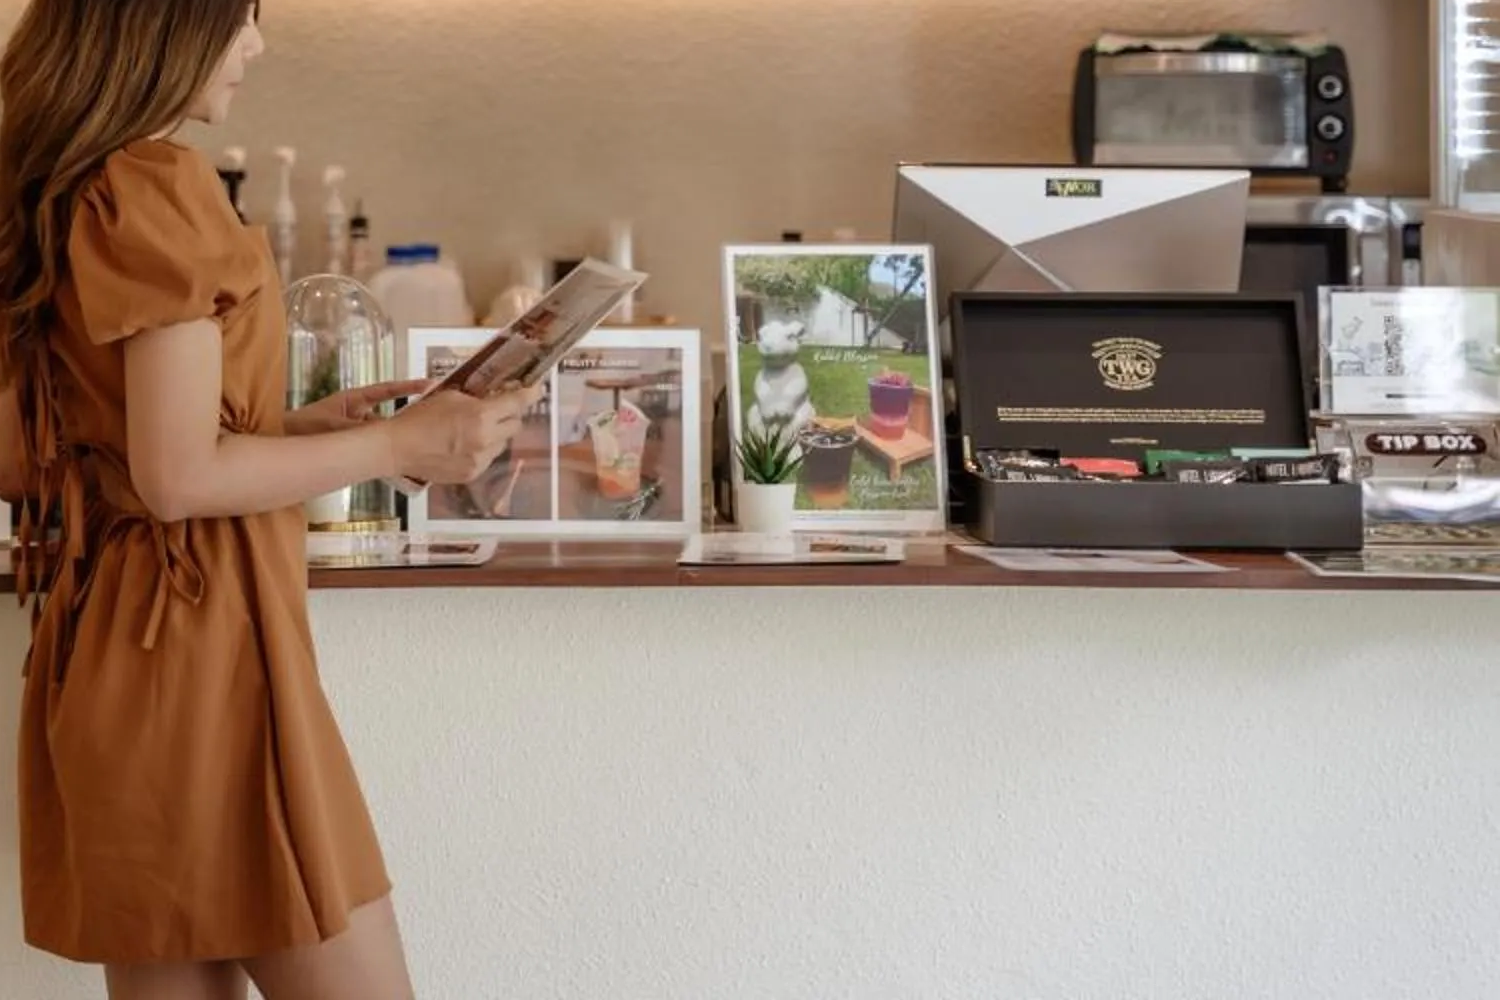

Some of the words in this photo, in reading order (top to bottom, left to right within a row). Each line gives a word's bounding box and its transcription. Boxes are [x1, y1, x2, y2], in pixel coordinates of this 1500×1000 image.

[1103, 359, 1152, 375] TWG
[1377, 434, 1419, 451] TIP
[1423, 434, 1477, 450] BOX
